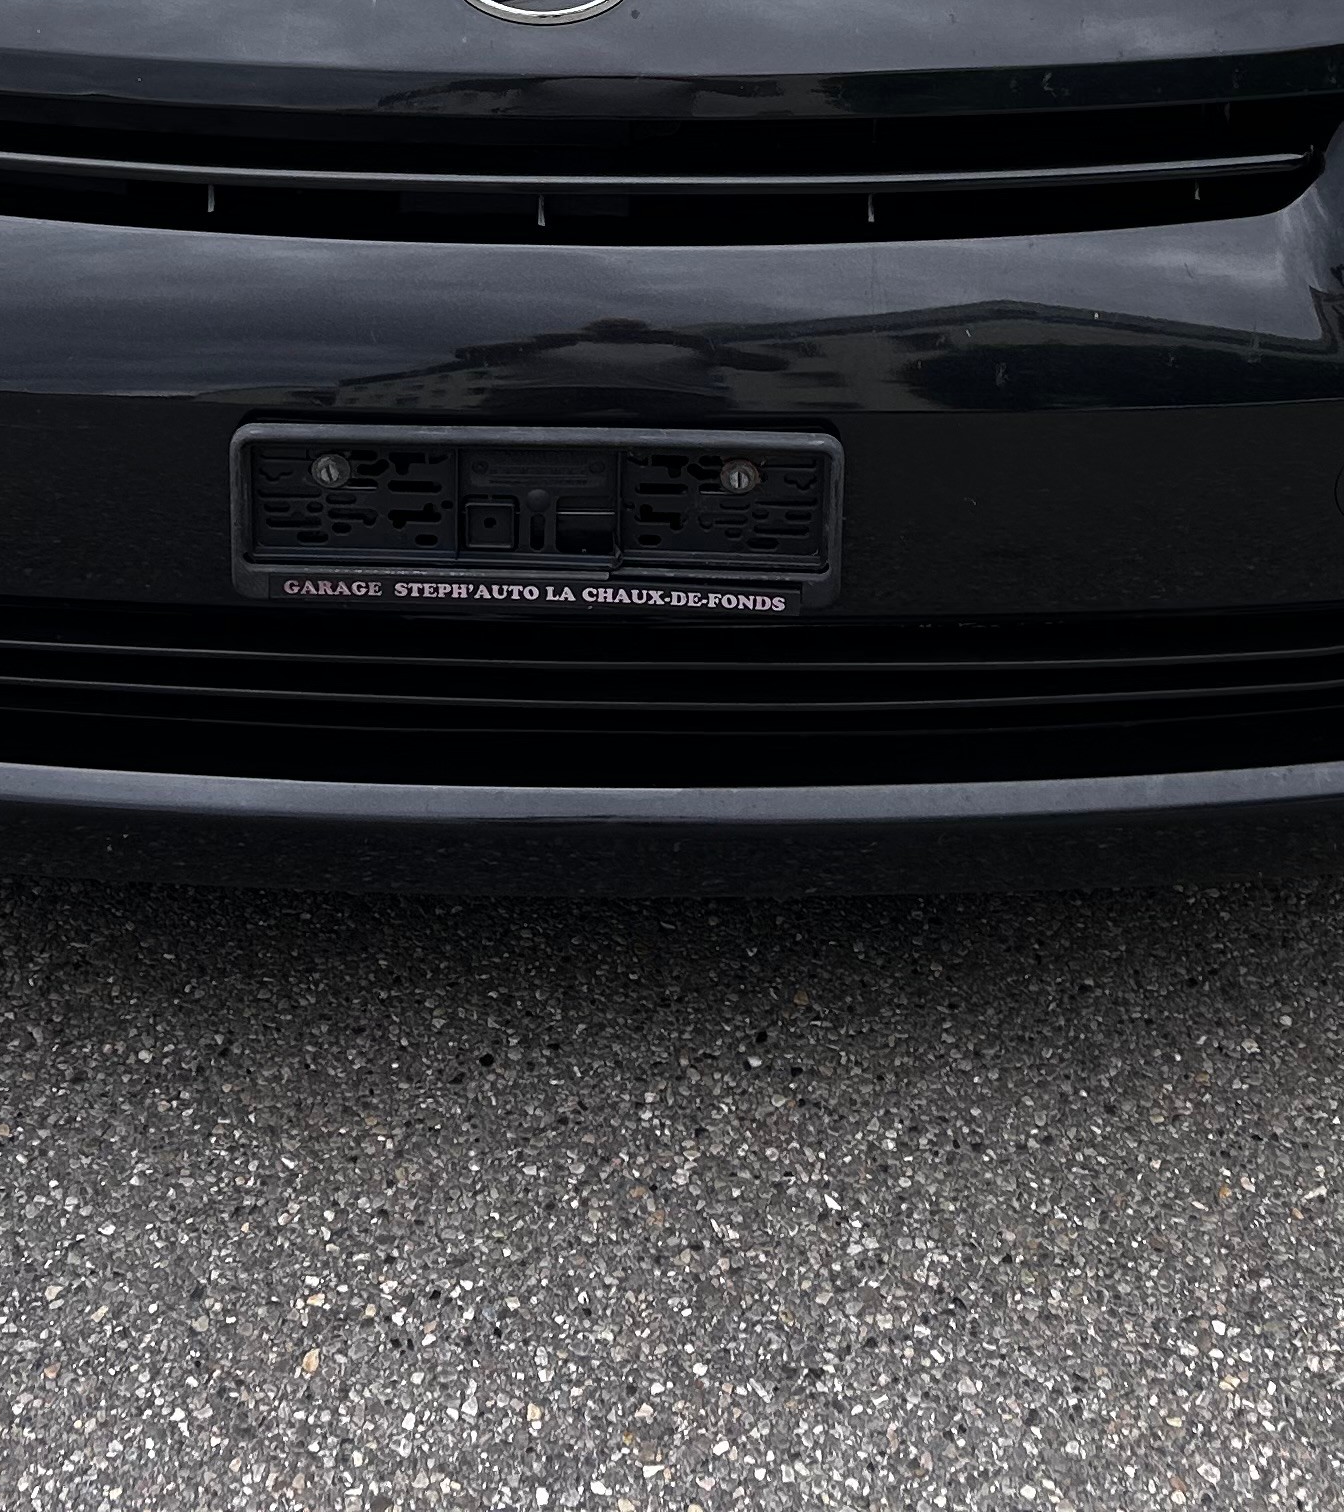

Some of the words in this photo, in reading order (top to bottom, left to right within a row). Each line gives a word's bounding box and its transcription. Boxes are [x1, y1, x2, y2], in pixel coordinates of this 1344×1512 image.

[283, 580, 383, 597] GARAGE
[394, 581, 539, 601] STEPH'AUTO
[545, 586, 576, 602] LA
[582, 587, 786, 611] CHAUX-DE-FONDS
